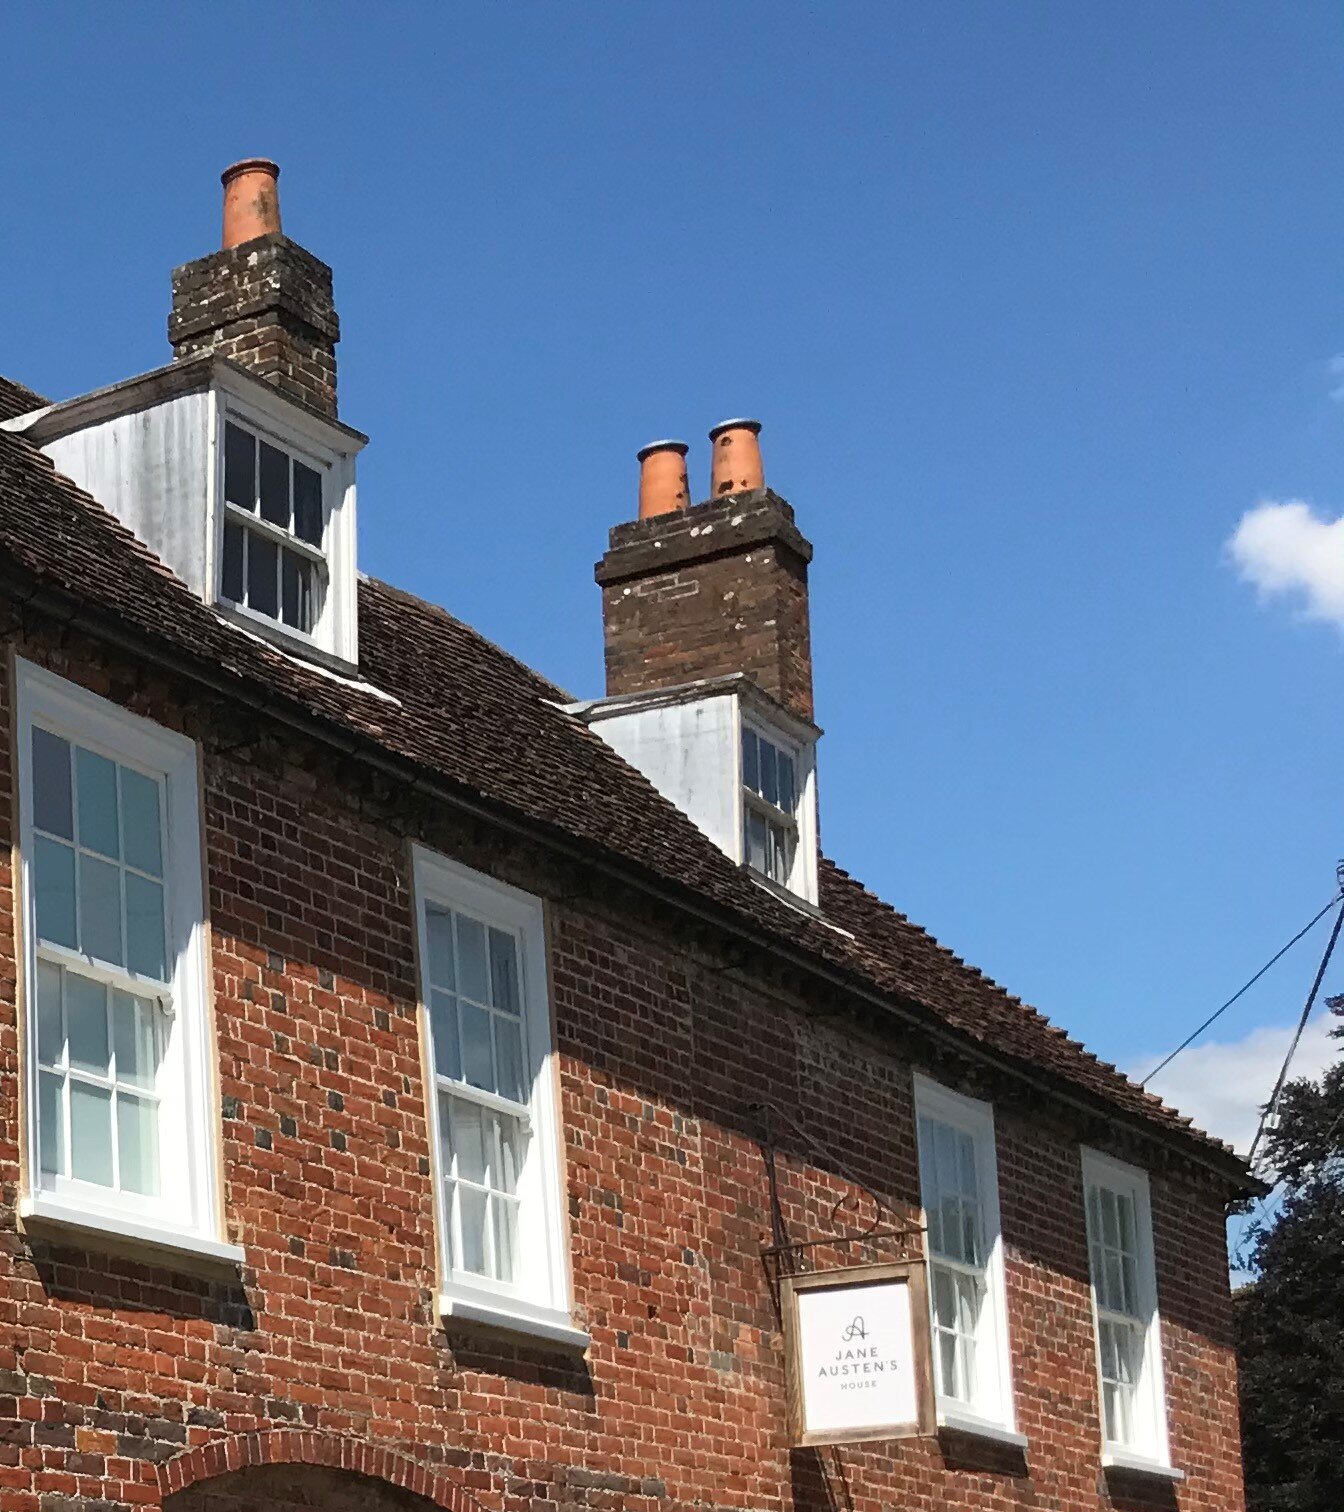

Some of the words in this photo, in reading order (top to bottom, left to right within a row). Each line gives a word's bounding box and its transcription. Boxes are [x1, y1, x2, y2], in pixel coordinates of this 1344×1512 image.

[835, 1347, 879, 1361] JANE
[818, 1360, 898, 1377] AUSTEN'S
[840, 1380, 877, 1390] HOUSE
